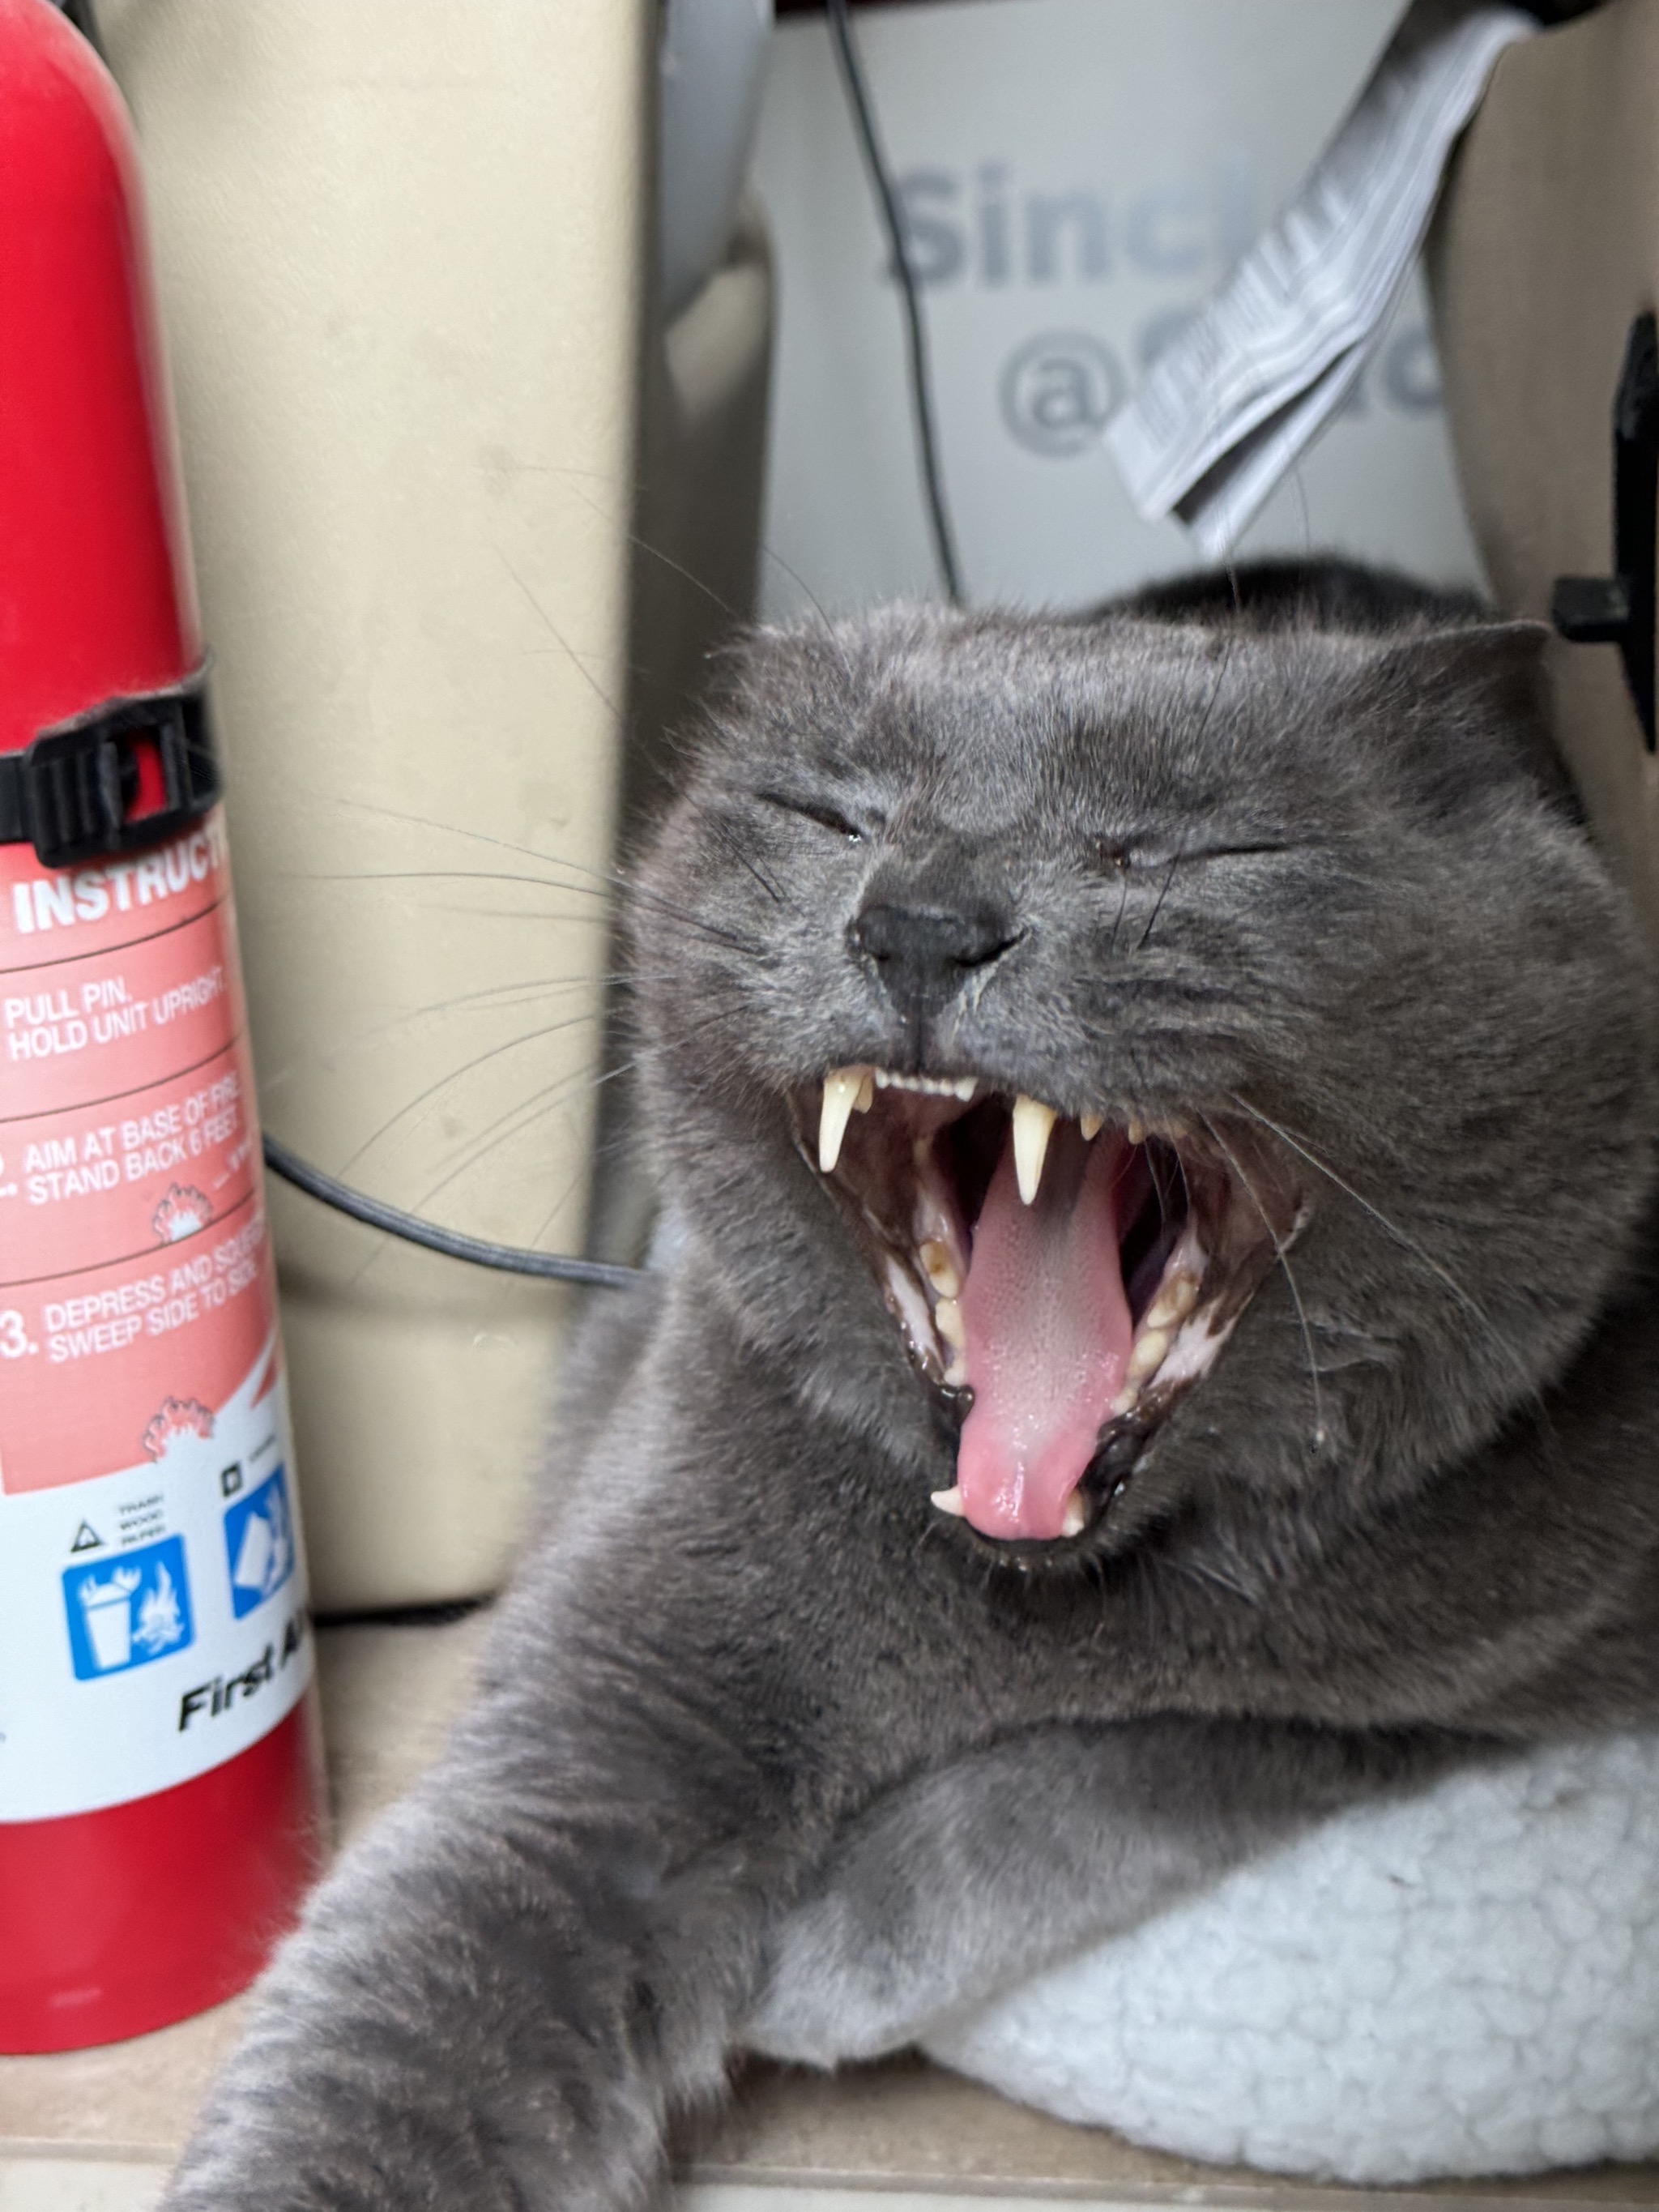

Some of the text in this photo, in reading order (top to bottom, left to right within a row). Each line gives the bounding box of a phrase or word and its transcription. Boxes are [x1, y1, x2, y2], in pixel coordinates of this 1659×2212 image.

[4, 975, 133, 1029] PULL PIN.
[8, 1019, 88, 1061] HOLD
[92, 1001, 149, 1044] UNIT
[24, 1137, 78, 1173] AIM
[83, 1126, 117, 1159] AT
[122, 1104, 181, 1151] BASE
[184, 1091, 208, 1125] OF
[28, 1159, 121, 1206] STAND
[125, 1137, 187, 1182] BACK
[188, 1129, 203, 1157] 6
[45, 1253, 212, 1334] DEPRESS AND
[49, 1309, 143, 1364] SWEEP
[147, 1292, 199, 1336] SIDE
[199, 1278, 226, 1311] TO
[179, 1640, 274, 1732] First
